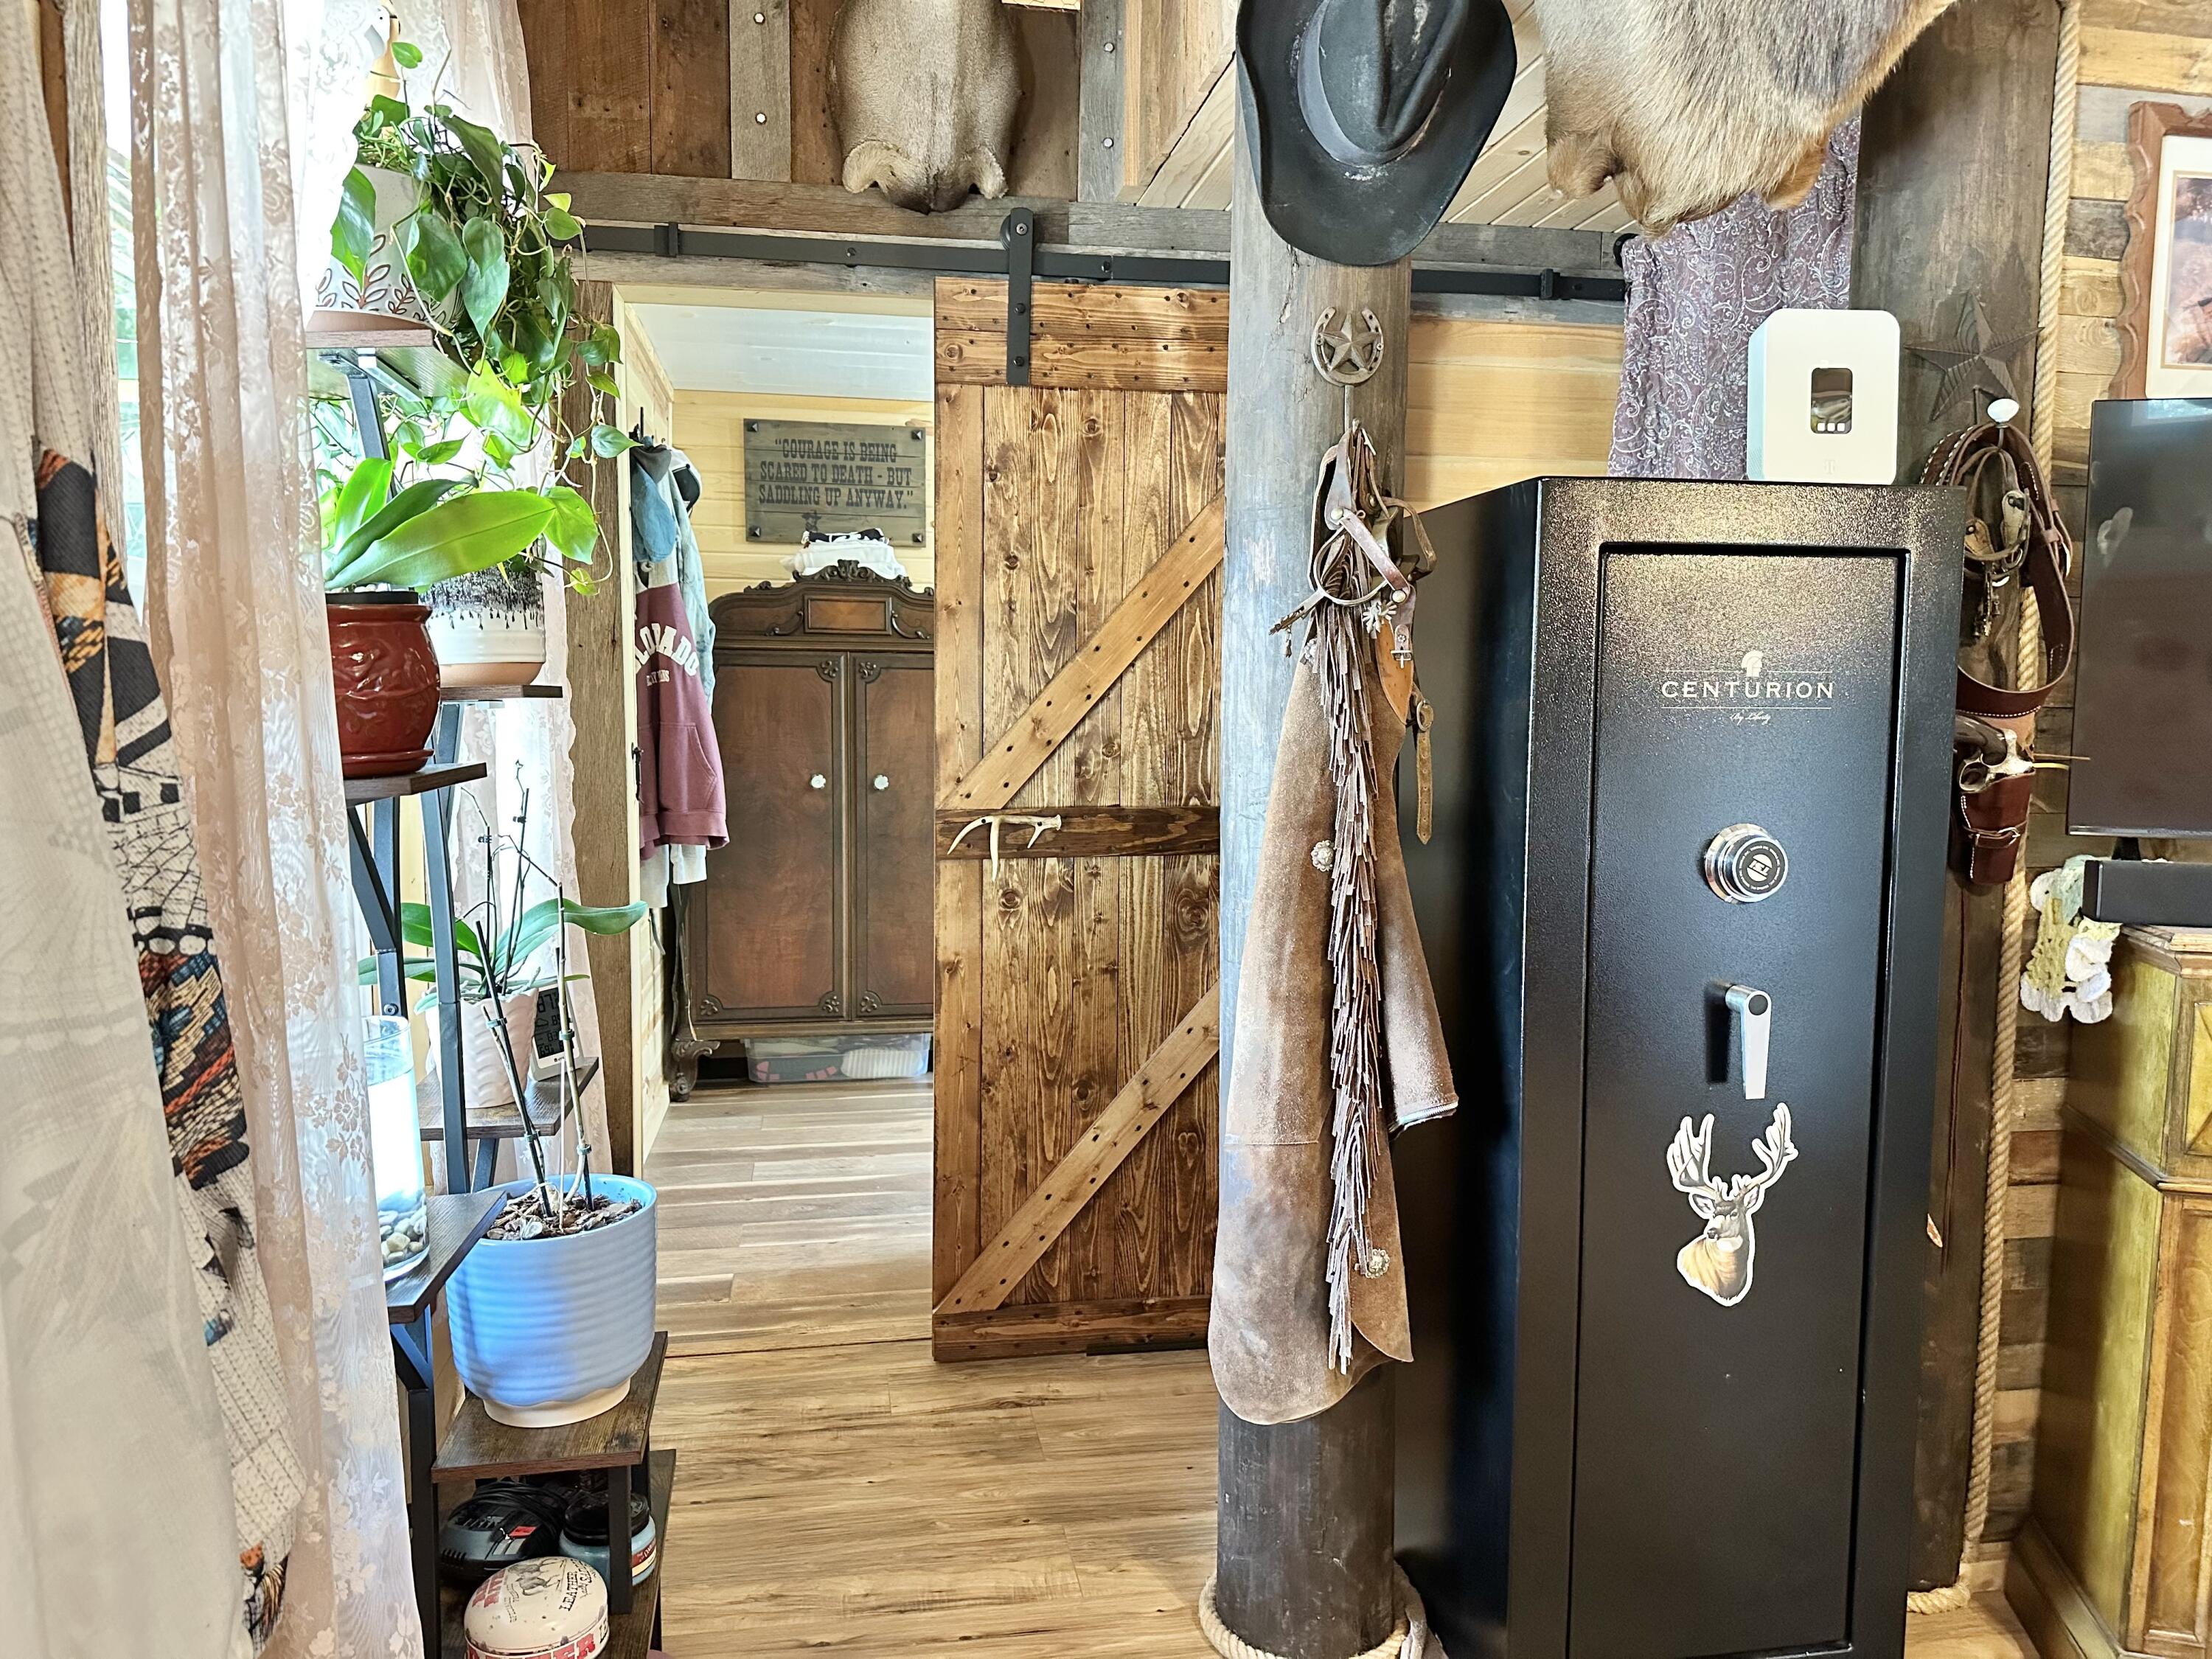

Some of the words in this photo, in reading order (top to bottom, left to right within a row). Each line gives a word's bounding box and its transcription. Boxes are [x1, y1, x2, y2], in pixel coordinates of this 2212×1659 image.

[844, 441, 855, 462] IS
[860, 442, 897, 463] BEING
[760, 460, 807, 481] SCARED
[811, 463, 828, 483] TO
[831, 465, 873, 485] DEATH
[886, 467, 912, 487] BUT
[759, 484, 821, 506] SADDLING
[825, 488, 841, 507] UP
[1661, 681, 1834, 699] CENTURION
